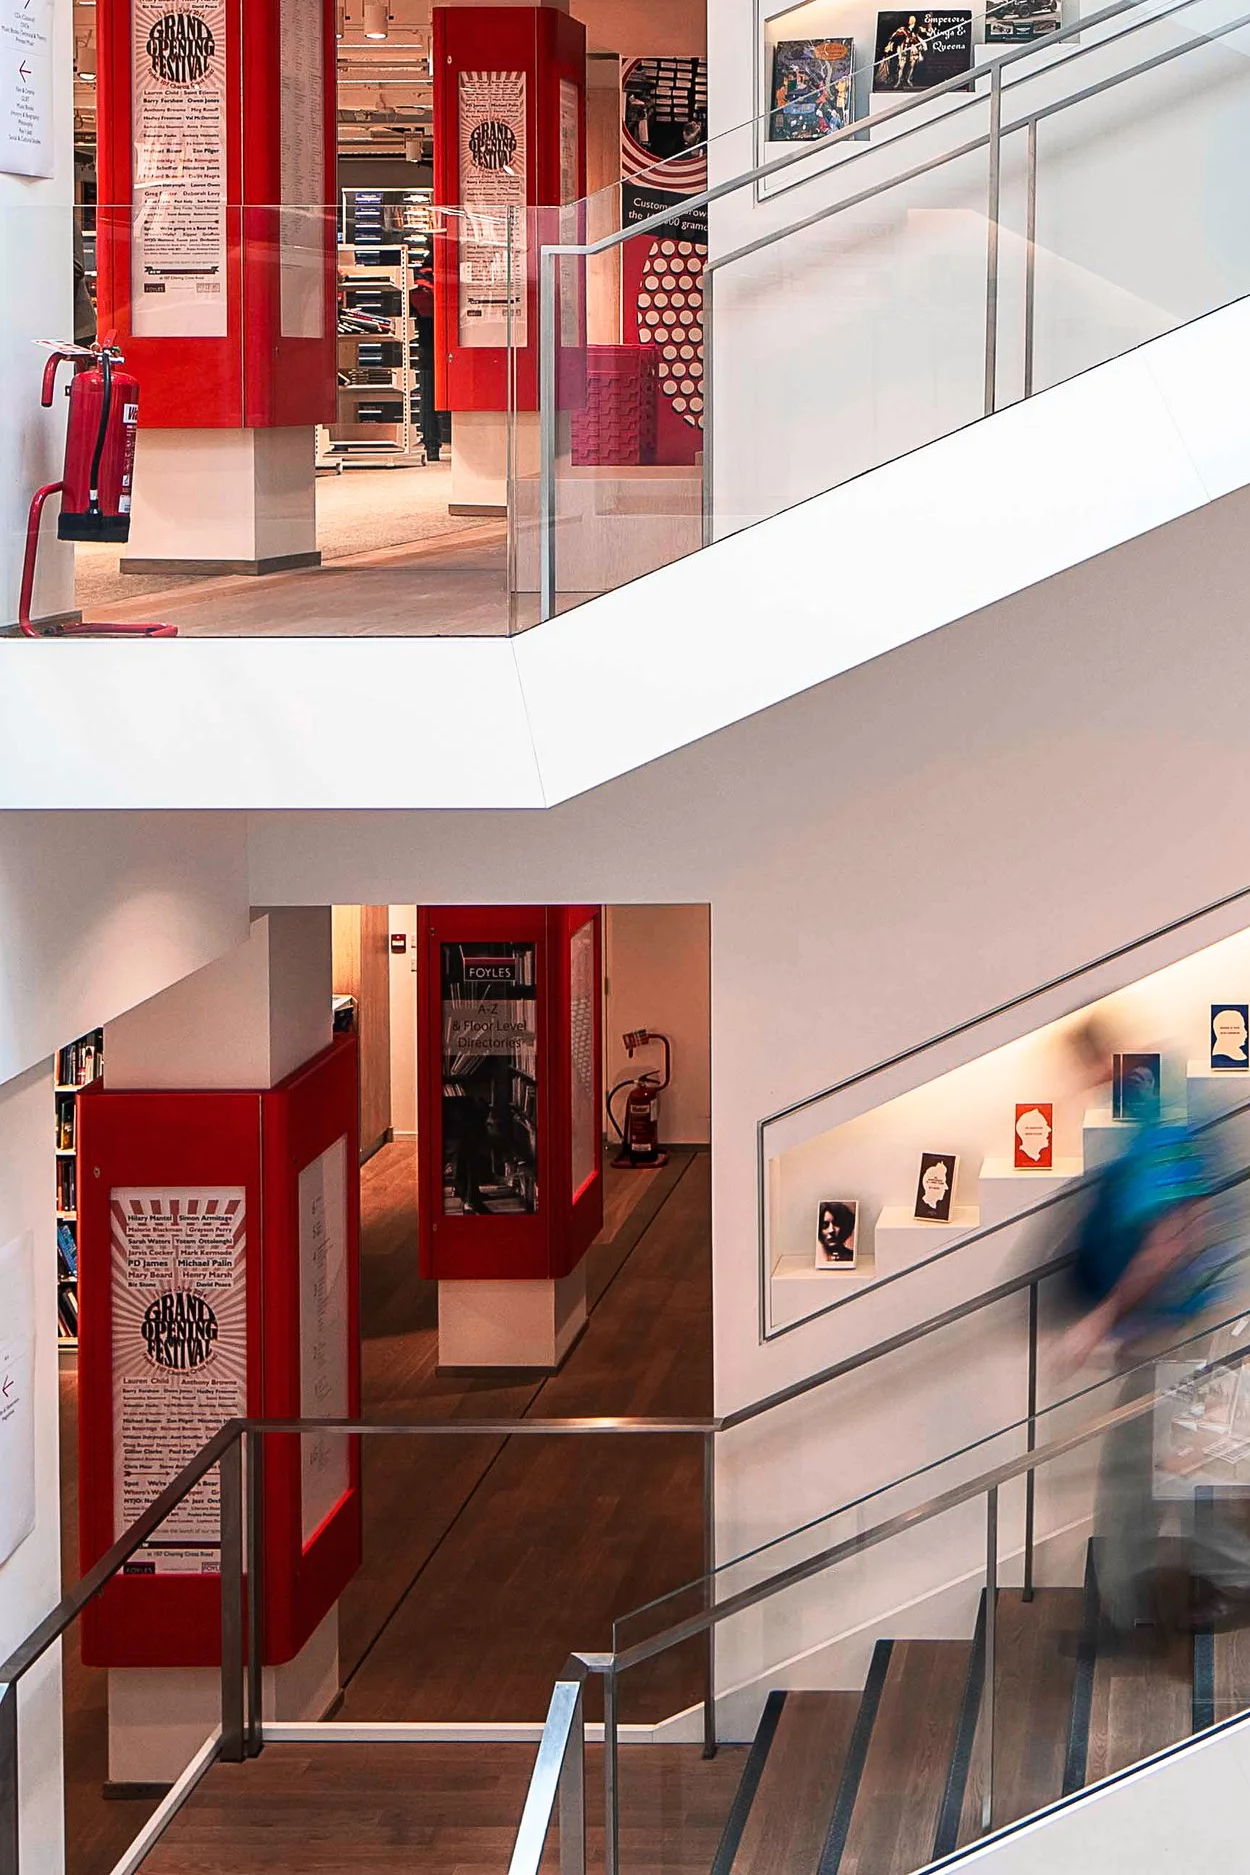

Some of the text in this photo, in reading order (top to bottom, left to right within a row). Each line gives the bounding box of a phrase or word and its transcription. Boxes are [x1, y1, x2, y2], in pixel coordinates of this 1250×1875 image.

[149, 13, 213, 39] GRAND
[146, 39, 216, 57] OPENING
[932, 41, 966, 52] Queens
[151, 55, 211, 83] FESTIVAL
[470, 121, 516, 139] GRAND
[468, 139, 517, 153] OPENING
[472, 151, 514, 169] FESTIVAL
[629, 211, 643, 220] the
[469, 967, 511, 979] FOYLES
[478, 1003, 498, 1015] A-Z
[452, 1020, 527, 1032] & Floor Level
[458, 1037, 522, 1049] Directories
[144, 1292, 216, 1322] GRAND
[140, 1320, 219, 1342] OPENING
[146, 1338, 213, 1369] FESTIVAL
